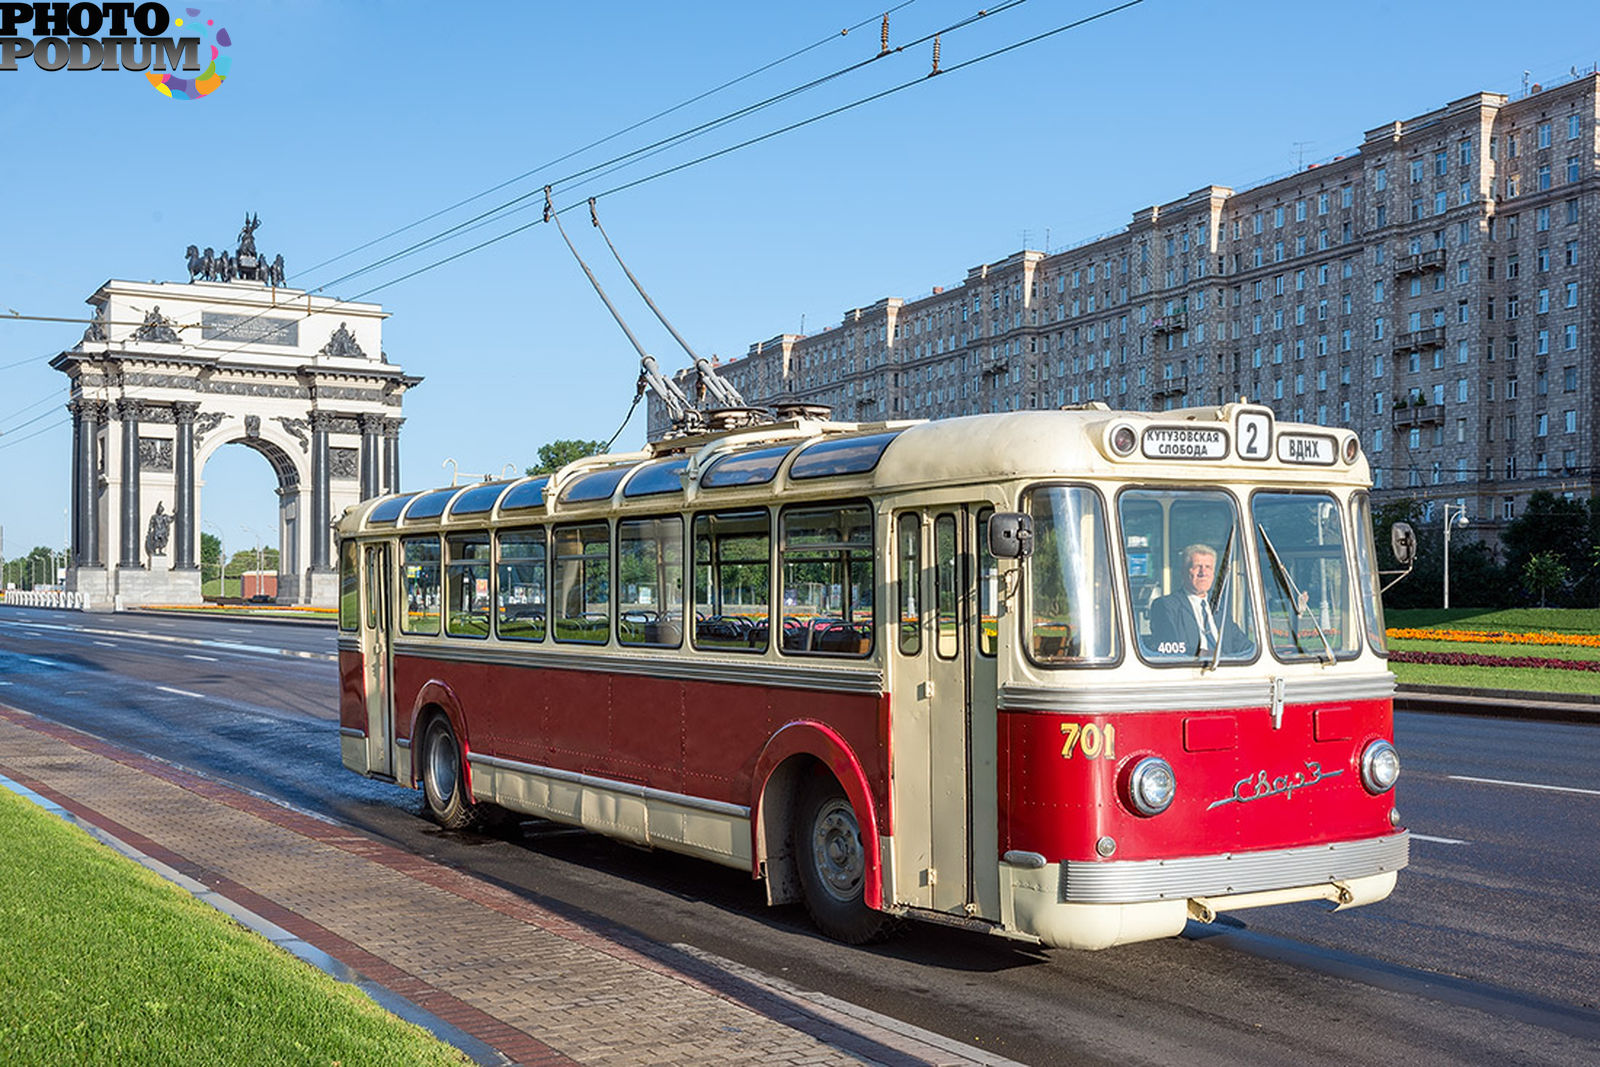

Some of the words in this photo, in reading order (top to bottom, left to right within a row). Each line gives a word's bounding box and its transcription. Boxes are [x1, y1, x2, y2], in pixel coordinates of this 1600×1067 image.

[1147, 431, 1220, 443] КУТУЗОВСКАЯ
[1246, 422, 1258, 454] 2
[1158, 444, 1208, 456] СЛОБОДА
[1289, 439, 1320, 460] ВДНХ
[1157, 641, 1187, 654] 4005
[1060, 722, 1117, 760] 701
